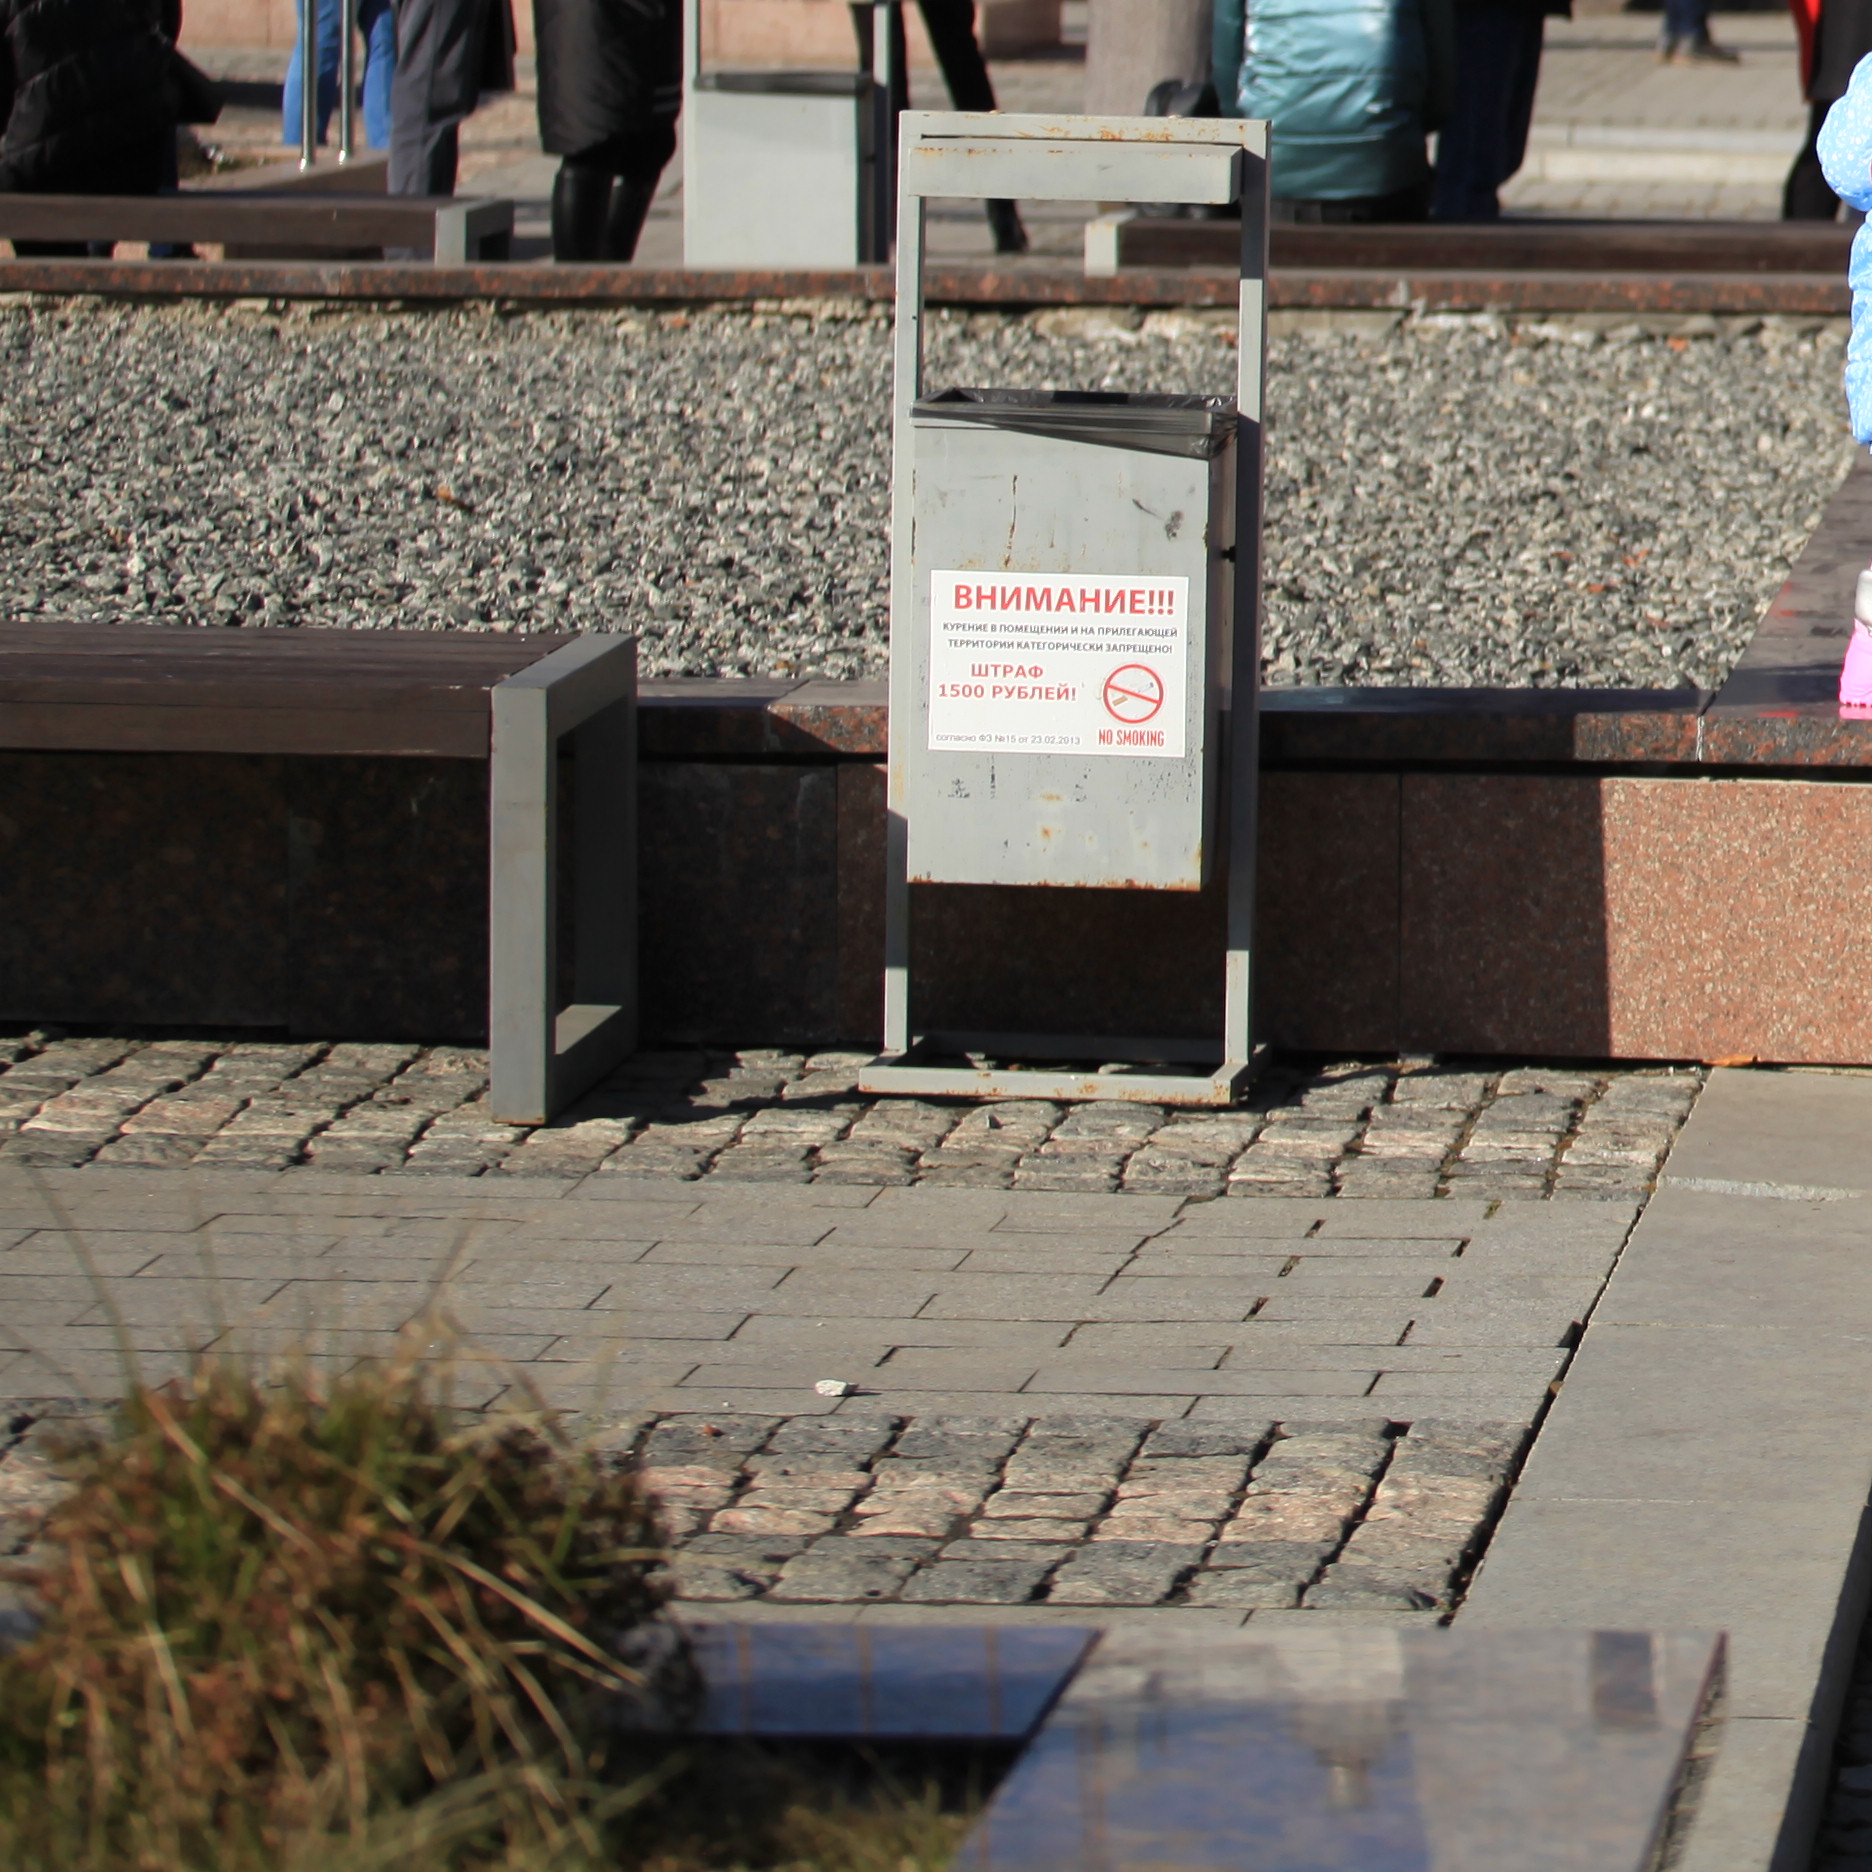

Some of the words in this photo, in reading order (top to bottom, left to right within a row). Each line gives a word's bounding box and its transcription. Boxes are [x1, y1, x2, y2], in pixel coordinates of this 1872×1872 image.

[954, 584, 1175, 616] ВНИМАНИЕ!!!
[943, 622, 989, 632] КУРЕНИЕ
[991, 623, 997, 632] В
[999, 624, 1069, 635] ПОМЕЩЕНИИ
[1071, 626, 1078, 635] И
[1080, 626, 1095, 636] НА
[1097, 626, 1178, 638] ПРИЛЕГАЮЩЕЙ
[948, 639, 1014, 650] ТЕРРИТОРИИ
[1017, 640, 1103, 652] КАТЕГОРИЧЕСКИ
[1105, 643, 1173, 655] ЗАПРЕЩЕНО!
[971, 663, 1044, 679] ШТРАФ
[938, 684, 985, 699] 1500
[992, 683, 1077, 702] РУБЛЕЙ!
[936, 734, 977, 743] согласно
[979, 734, 992, 743] ФЗ
[995, 735, 1017, 744] №15
[1019, 736, 1029, 744] от
[1031, 735, 1081, 746] 23.02.2013
[1099, 729, 1113, 746] NO
[1116, 730, 1165, 747] SMOKING
